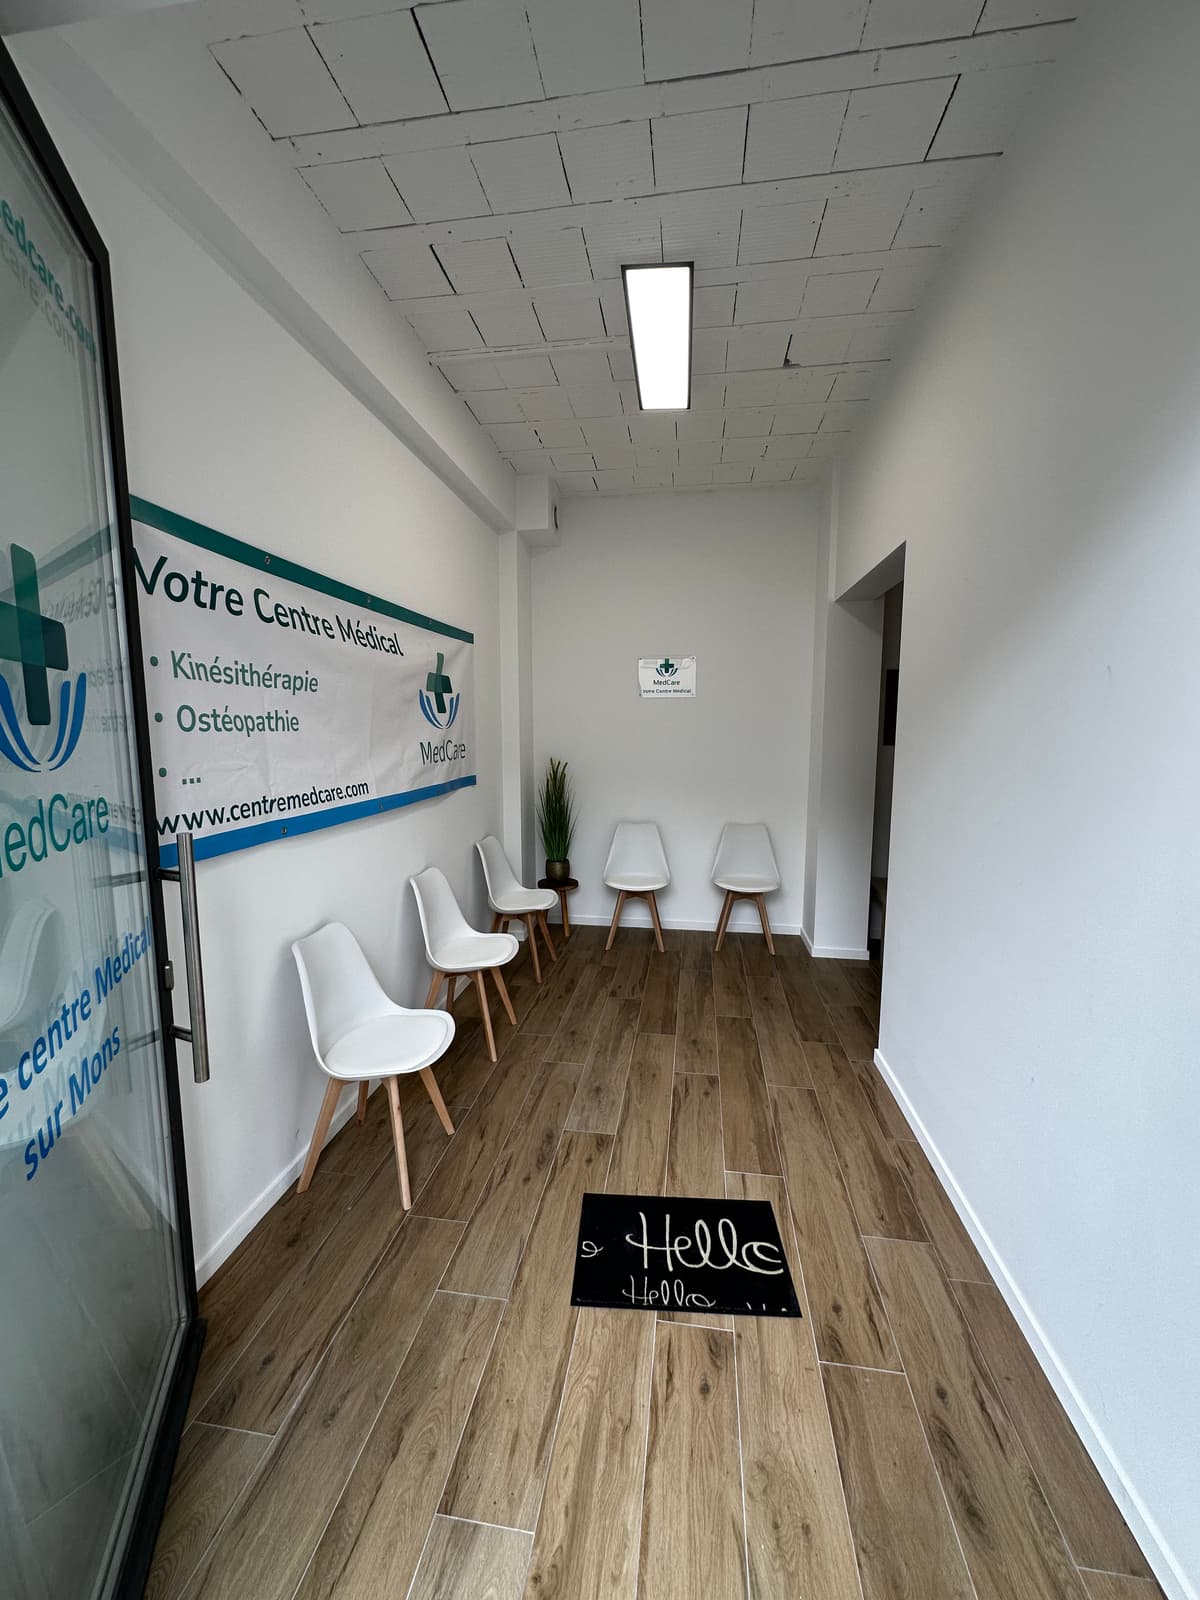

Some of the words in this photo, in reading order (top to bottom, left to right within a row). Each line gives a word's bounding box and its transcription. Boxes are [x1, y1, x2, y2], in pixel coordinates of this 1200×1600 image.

[0, 199, 96, 363] edcare.com
[131, 547, 243, 616] Votre
[254, 588, 335, 641] Centre
[336, 615, 404, 657] Médical
[170, 650, 319, 696] Kinésithérapie
[176, 704, 300, 737] Ostéopathie
[419, 739, 466, 765] MedCare
[0, 790, 109, 879] edCare
[157, 780, 370, 835] www.centremedcare.com
[18, 988, 91, 1091] centre
[95, 918, 151, 1004] Medical
[24, 1100, 63, 1182] sur
[68, 1026, 120, 1116] Mons
[621, 1275, 716, 1307] Hello
